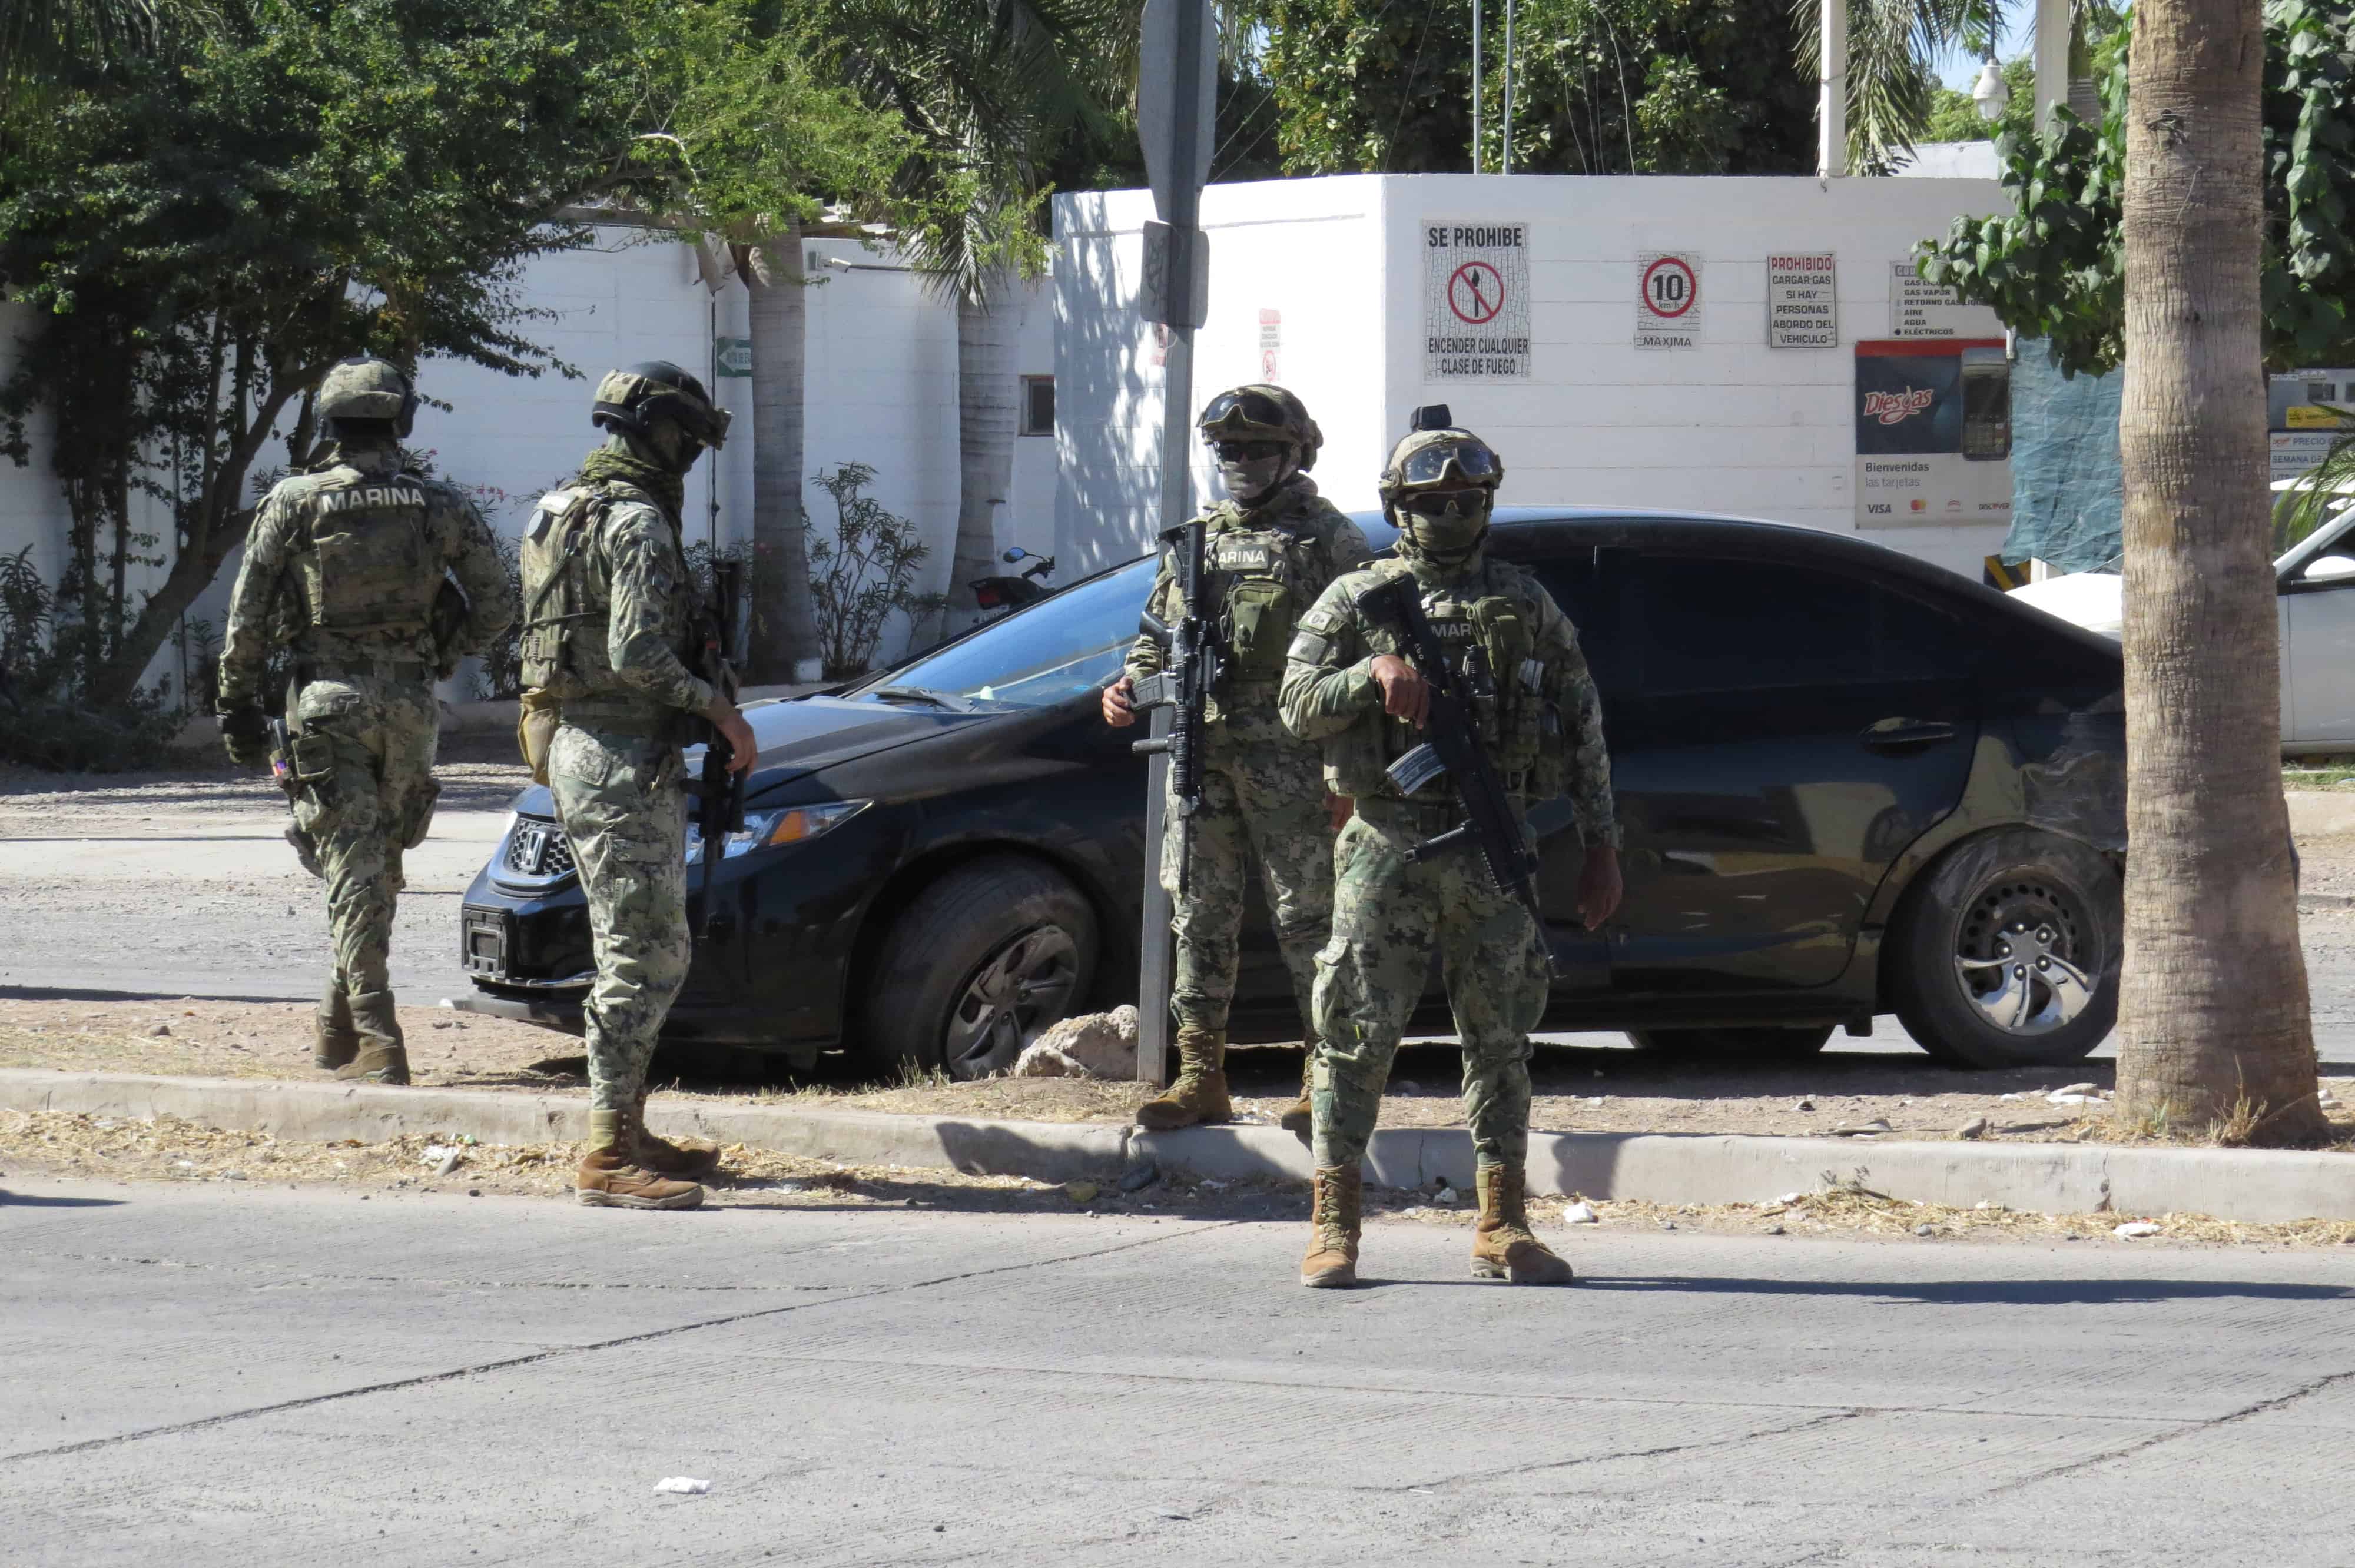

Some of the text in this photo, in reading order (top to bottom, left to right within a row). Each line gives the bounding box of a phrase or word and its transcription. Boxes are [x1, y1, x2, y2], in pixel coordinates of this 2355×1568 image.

[1429, 227, 1522, 247] SE PROHIBE
[1771, 257, 1832, 271] PROHIBIDO
[1773, 275, 1831, 284] CARGAR GAS
[1653, 274, 1683, 301] 10
[1786, 291, 1817, 299] SI HAY
[1776, 305, 1829, 314] PERSONAS
[1773, 320, 1834, 329] ABORDO DEL
[1429, 338, 1529, 354] ENCENDER CUALQUIER
[1780, 335, 1827, 344] VEHICULO
[1442, 358, 1515, 374] CLASE DE FUEGO
[1864, 386, 1935, 425] Diesgas
[1866, 462, 1929, 472] Bienvenidas
[1866, 477, 1921, 489] las tarjetas
[322, 487, 426, 513] MARINA
[1868, 504, 1892, 514] VISA
[1218, 550, 1266, 564] ARINA
[1430, 623, 1471, 637] MAR
